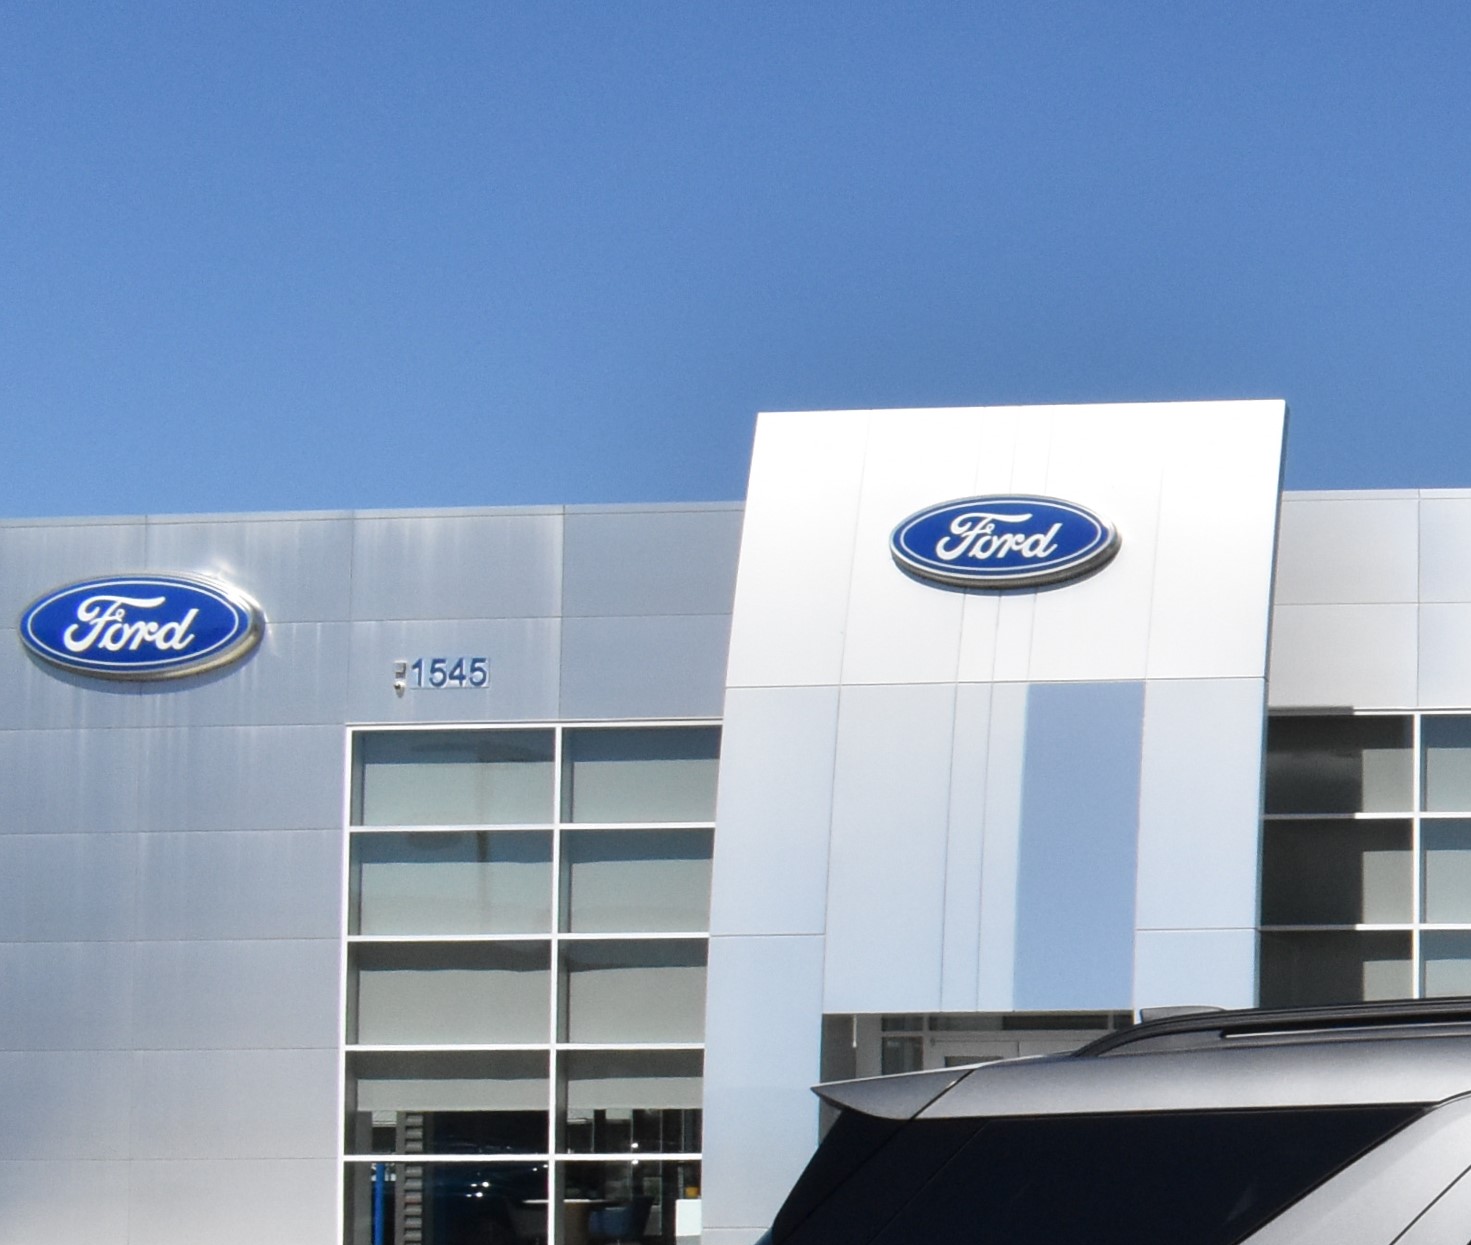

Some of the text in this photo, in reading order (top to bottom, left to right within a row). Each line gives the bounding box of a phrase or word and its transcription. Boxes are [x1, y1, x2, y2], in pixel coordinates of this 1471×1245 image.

[935, 512, 1063, 561] Ford
[63, 595, 198, 652] Ford
[412, 657, 488, 687] 1545
